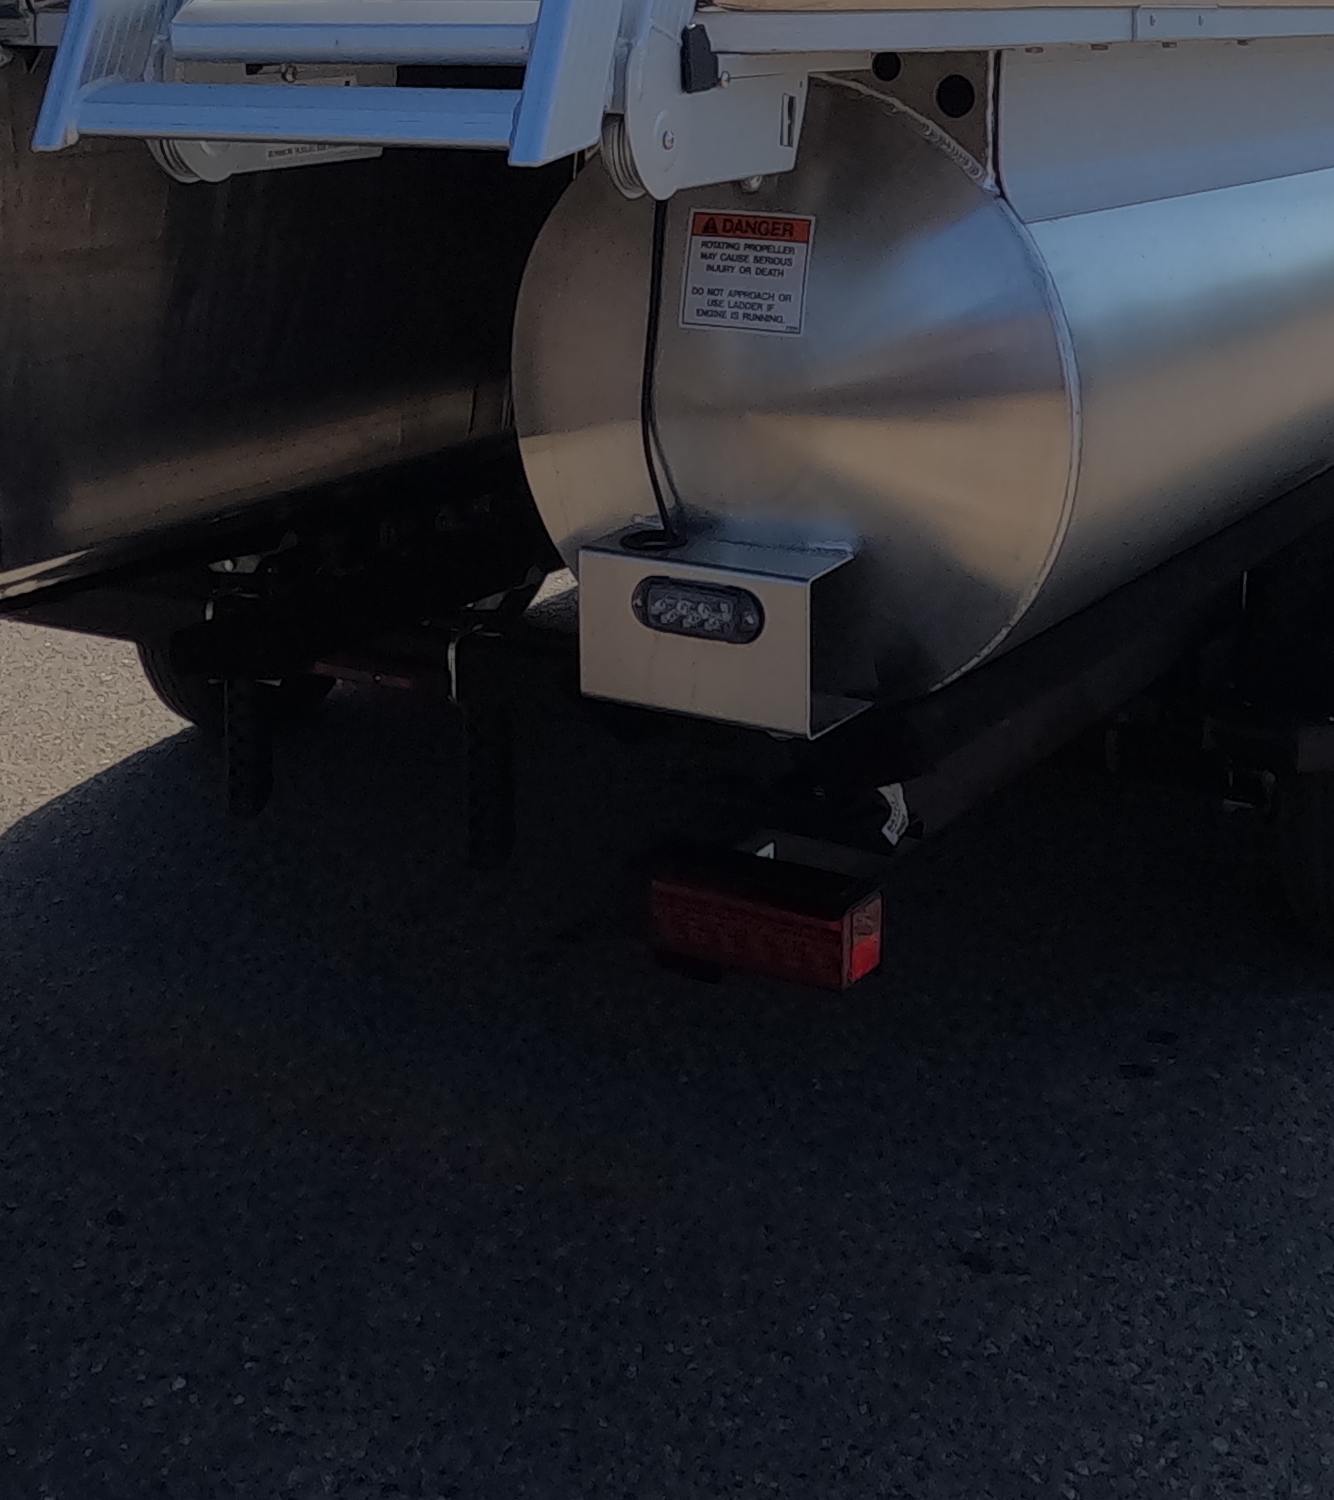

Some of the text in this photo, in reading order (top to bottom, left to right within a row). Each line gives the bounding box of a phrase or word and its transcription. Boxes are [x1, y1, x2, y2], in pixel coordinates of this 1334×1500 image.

[722, 218, 794, 237] DANGER
[700, 241, 795, 255] ROTATING PROPELLER
[700, 252, 793, 267] MAY CAUSE SERIOUS
[705, 264, 784, 278] INJURY OR DEATH
[691, 286, 792, 303] DO NOT APPROACH OR
[707, 298, 725, 308] USE
[727, 300, 763, 311] LADDER
[696, 308, 727, 319] ENGINE
[730, 311, 740, 320] IS
